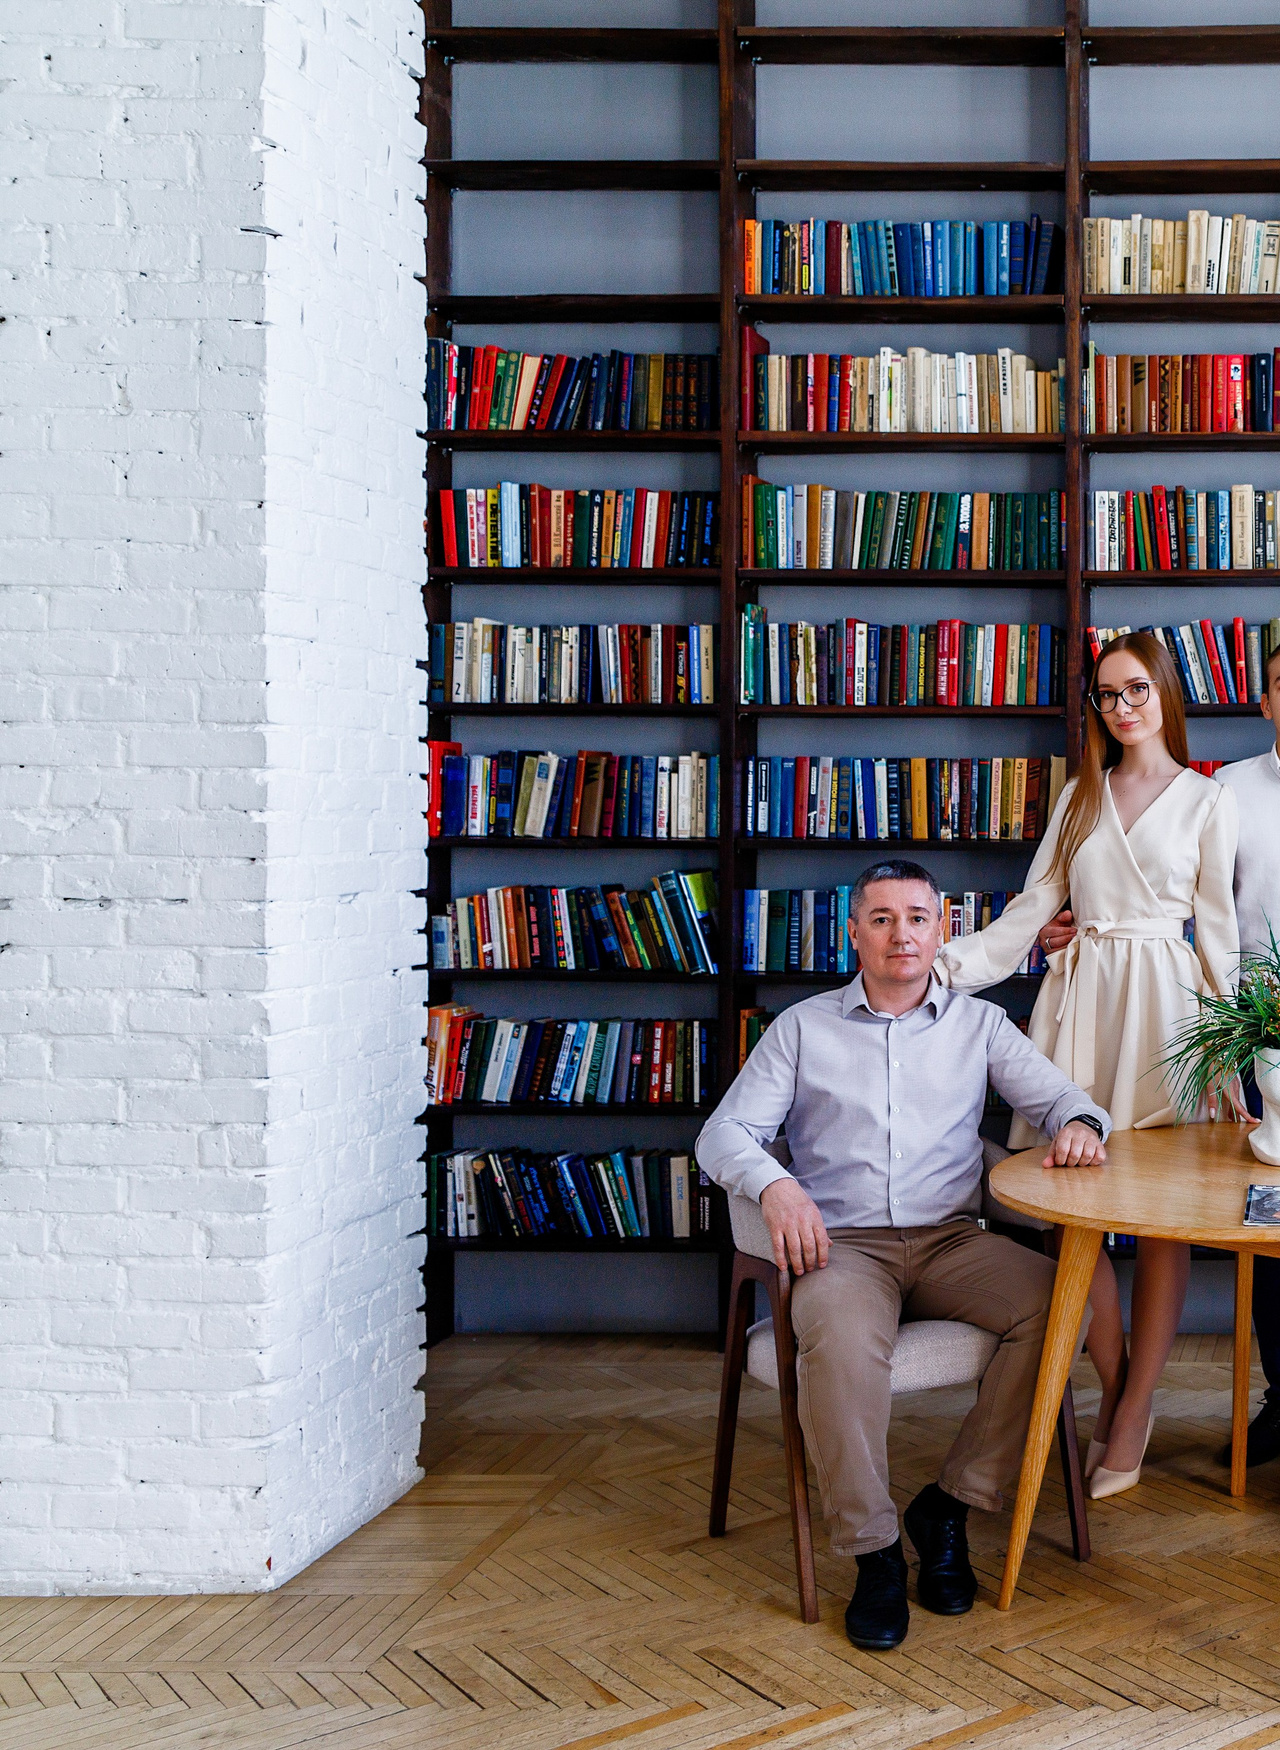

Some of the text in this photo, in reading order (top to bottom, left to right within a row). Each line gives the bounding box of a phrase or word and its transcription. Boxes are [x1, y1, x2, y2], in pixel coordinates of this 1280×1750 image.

[959, 493, 970, 529] Э.ТОПОЛЬ
[938, 658, 947, 696] ЗАЛОЖНИК
[469, 785, 478, 819] ЛИТЕРАТУРА
[1013, 771, 1024, 814] В.О.Ключевский
[585, 1032, 606, 1096] ЖОРЖ СИМЕНОН
